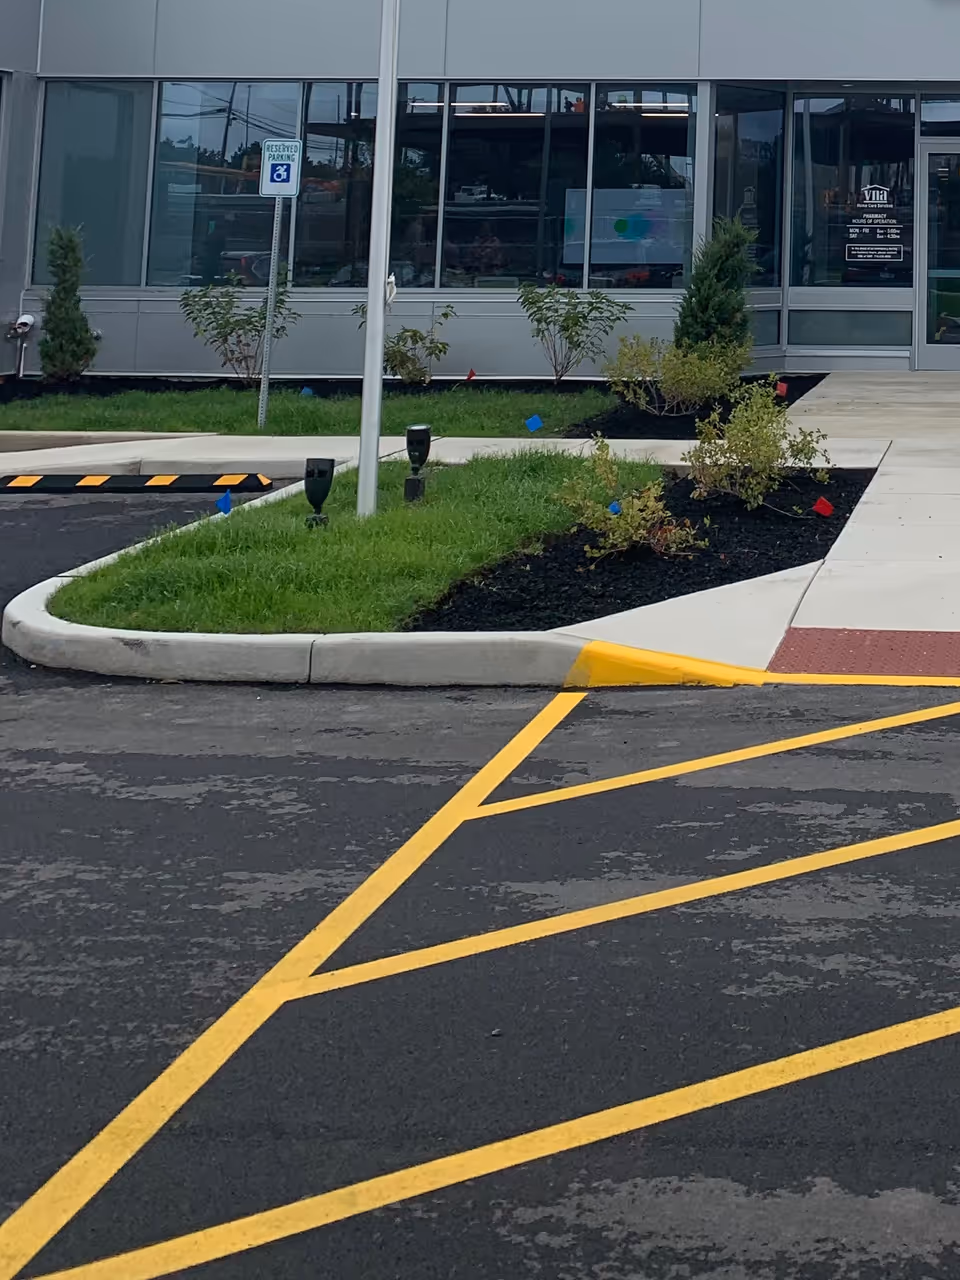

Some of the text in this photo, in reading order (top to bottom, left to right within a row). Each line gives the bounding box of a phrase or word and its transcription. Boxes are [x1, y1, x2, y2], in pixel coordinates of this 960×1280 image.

[266, 144, 298, 153] RESERVED
[268, 154, 295, 162] PARKING
[864, 190, 887, 200] vna
